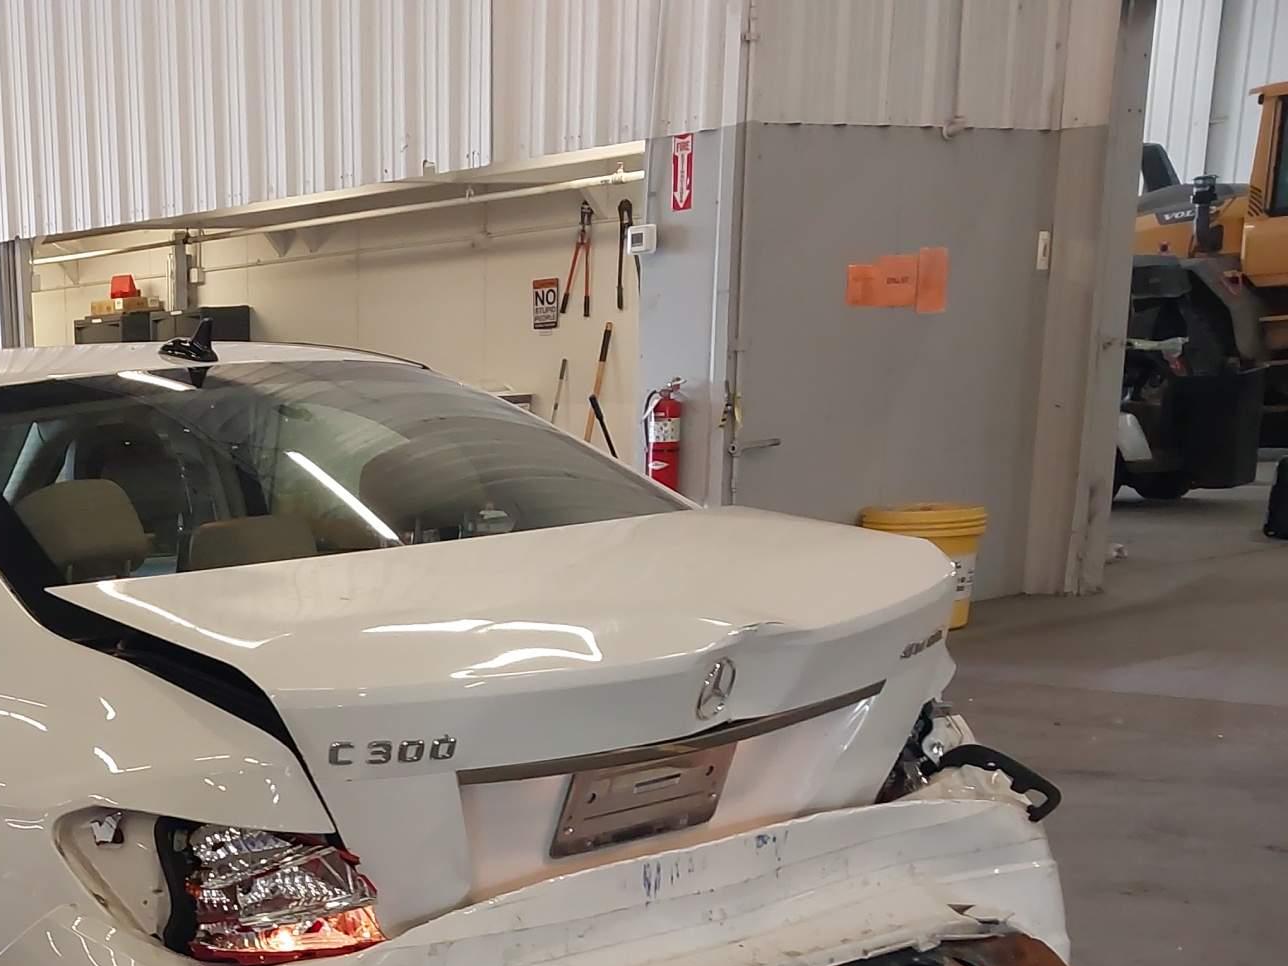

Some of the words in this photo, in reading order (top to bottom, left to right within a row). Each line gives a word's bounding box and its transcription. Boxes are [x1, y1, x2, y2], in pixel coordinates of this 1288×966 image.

[535, 289, 556, 306] NO
[328, 741, 354, 765] C
[366, 734, 457, 765] 300
